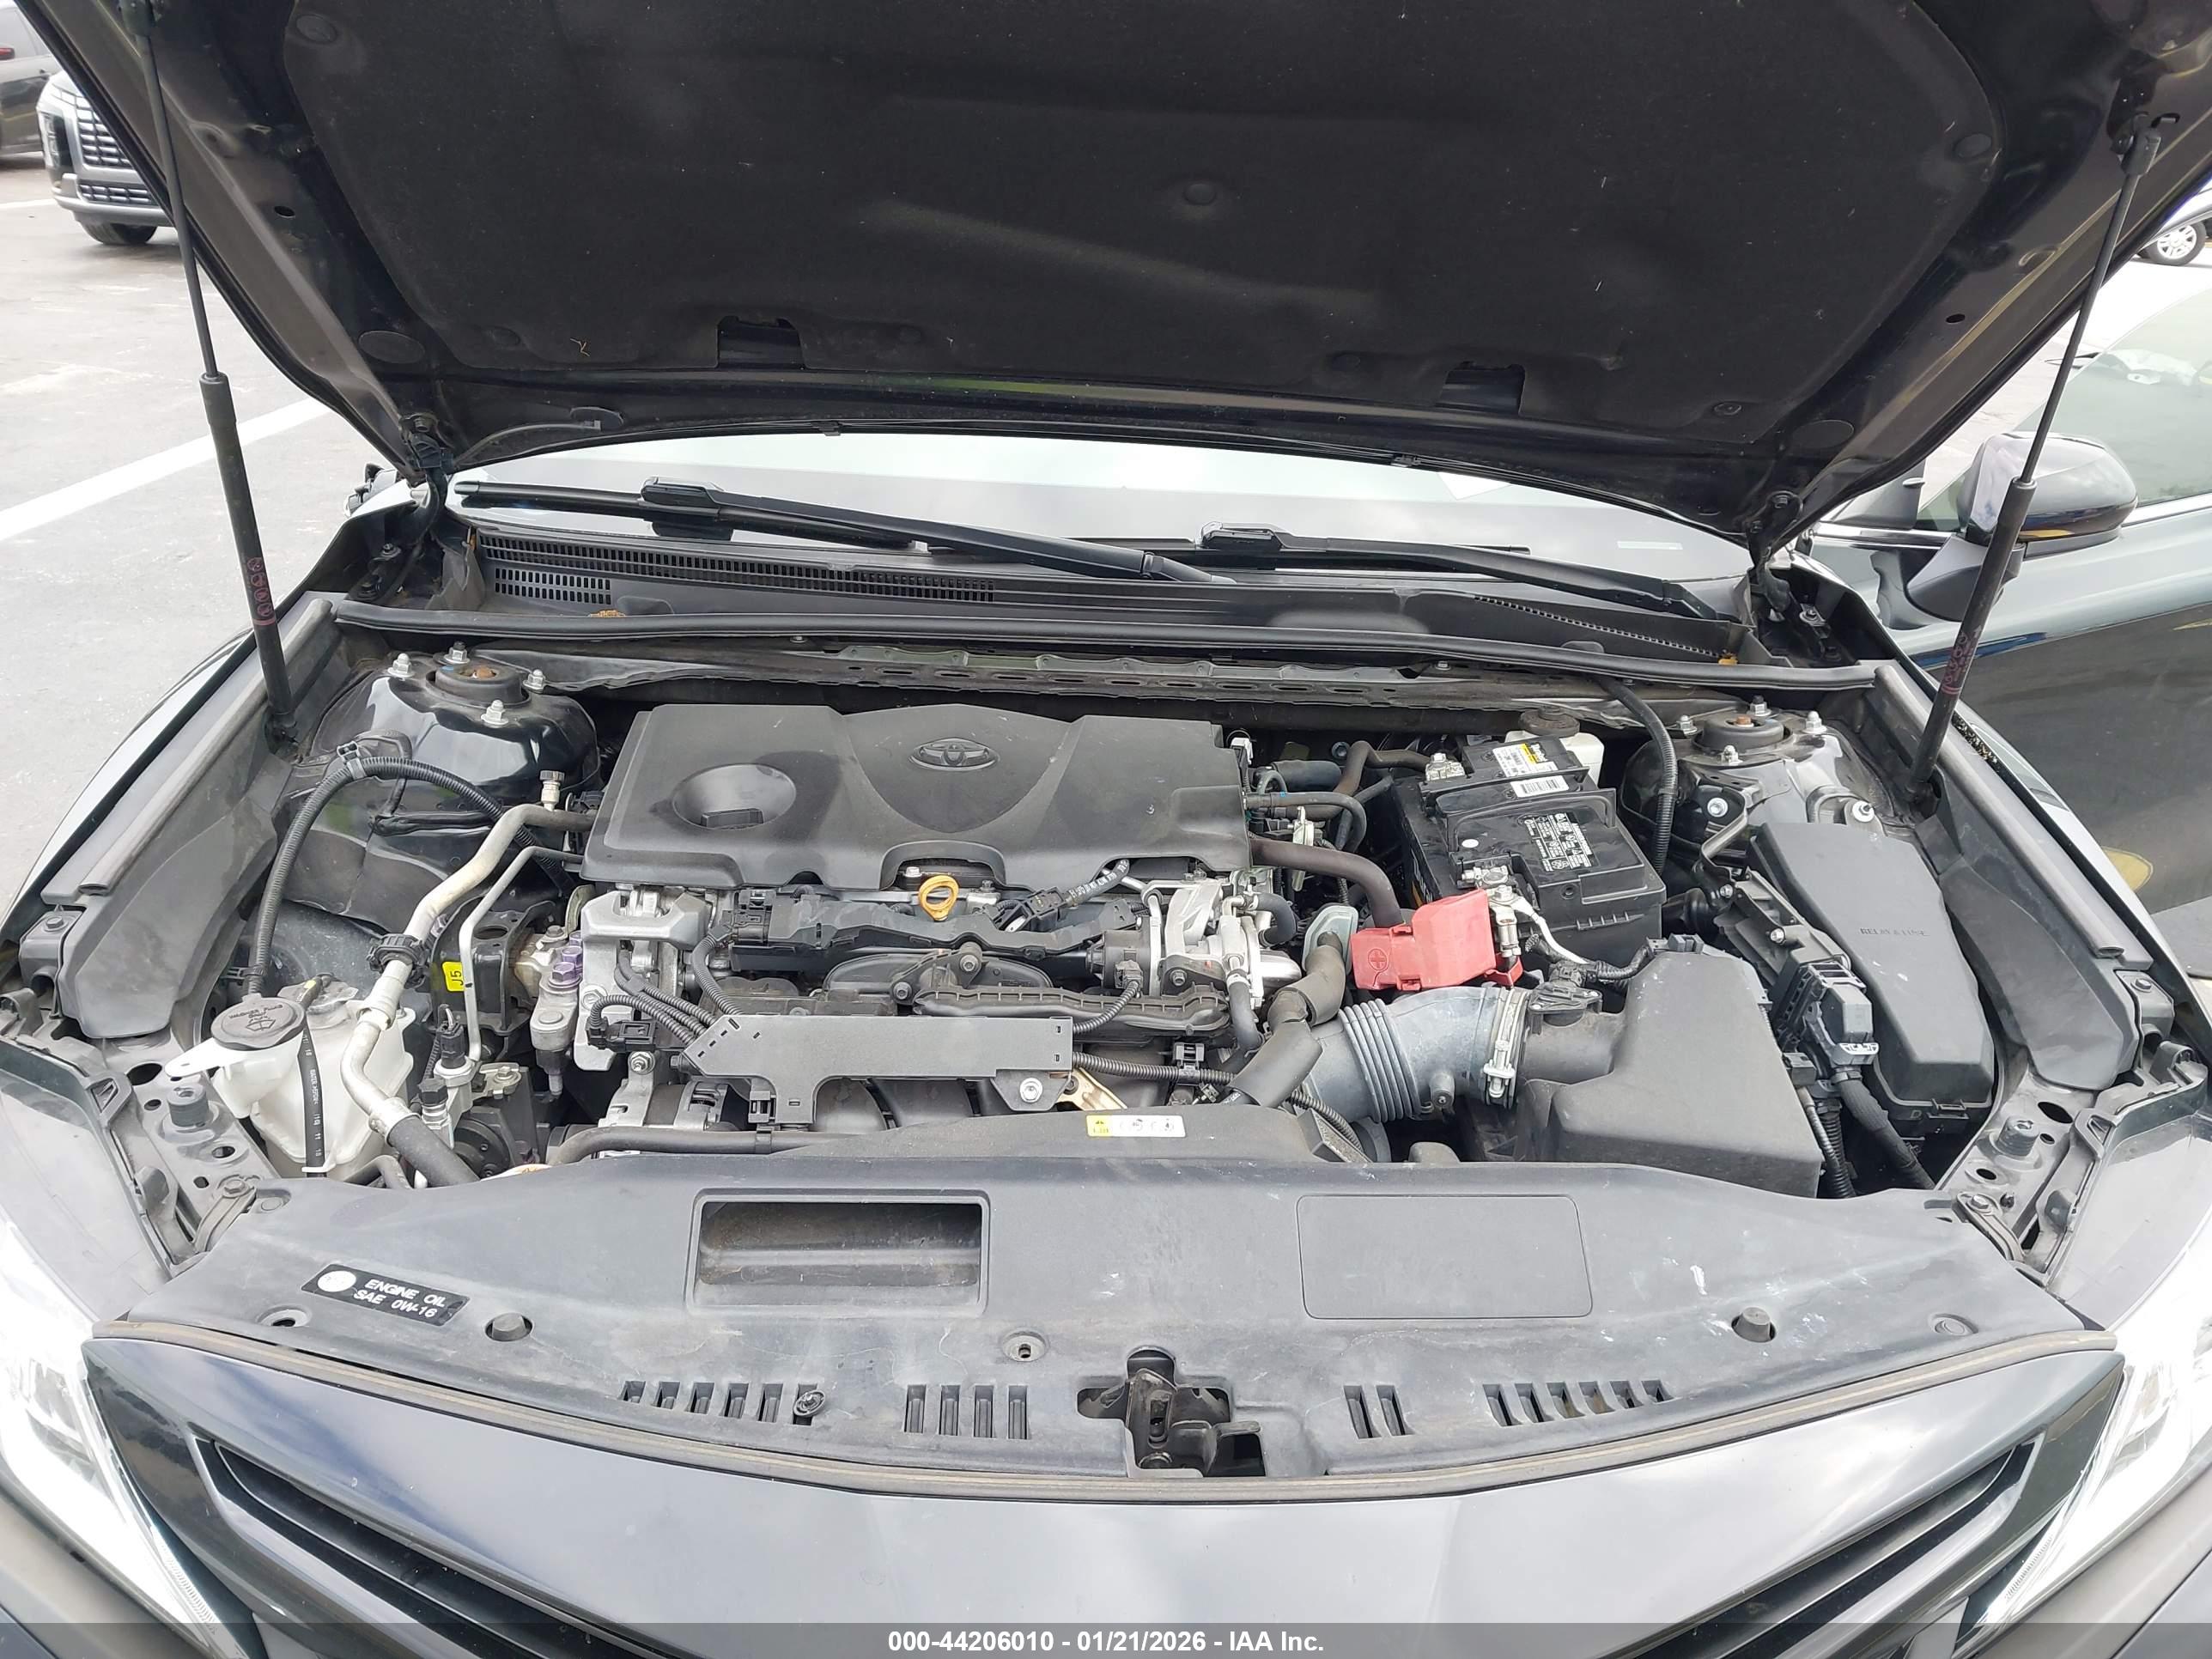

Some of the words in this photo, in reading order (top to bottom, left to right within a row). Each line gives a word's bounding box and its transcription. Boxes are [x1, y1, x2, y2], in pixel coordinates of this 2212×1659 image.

[449, 970, 465, 987] J5
[353, 1289, 387, 1304] SAE
[364, 1279, 420, 1300] ENGINE
[423, 1294, 447, 1308] OIL
